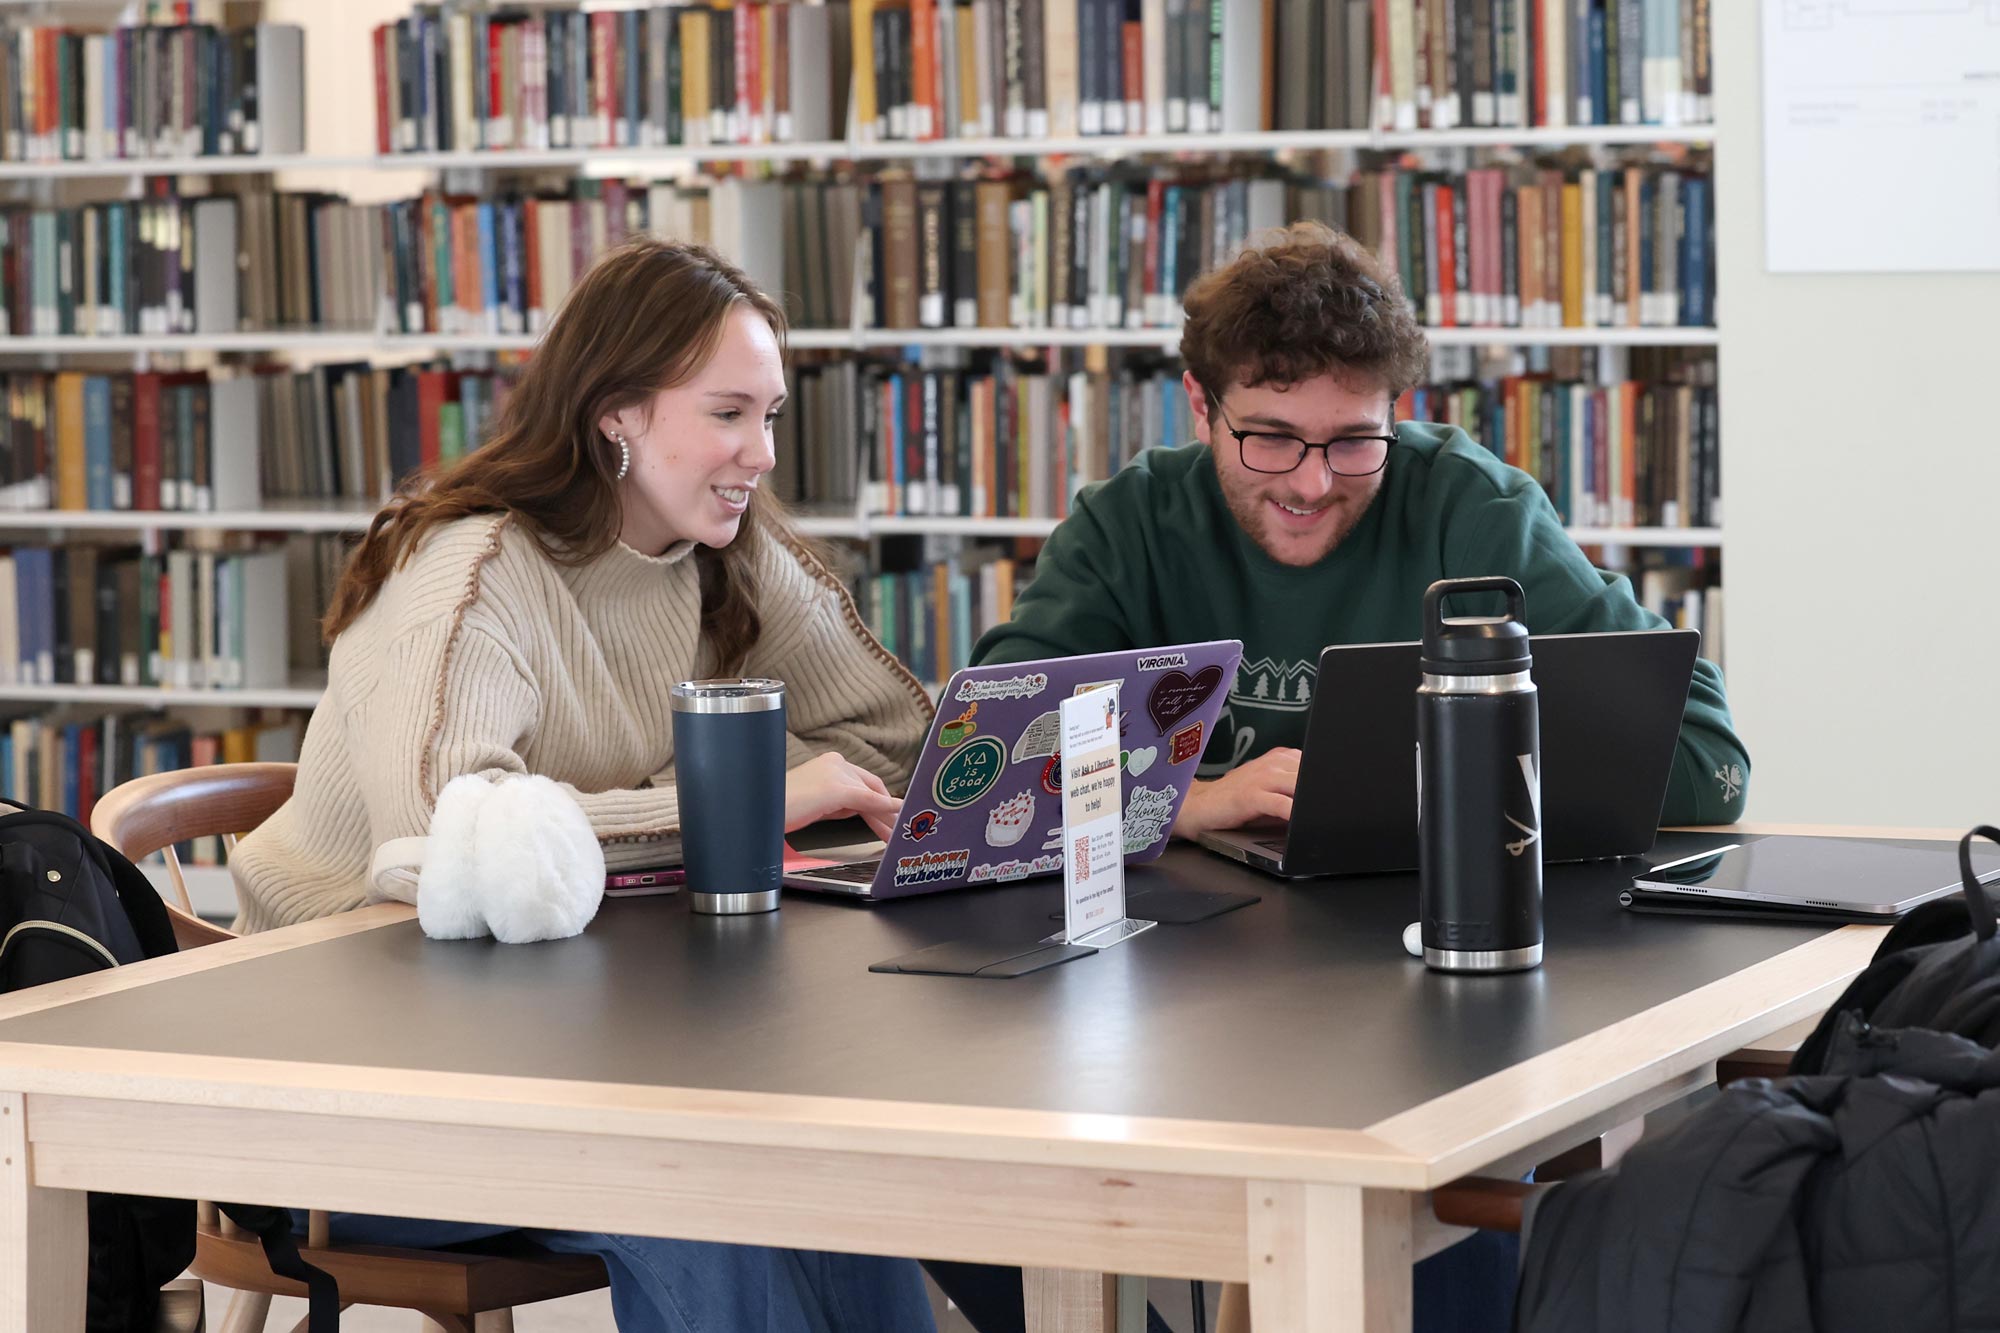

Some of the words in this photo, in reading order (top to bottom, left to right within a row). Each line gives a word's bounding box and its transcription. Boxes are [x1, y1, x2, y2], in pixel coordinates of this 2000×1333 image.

[1139, 656, 1184, 669] VIRGINIA
[1161, 704, 1182, 715] well
[965, 767, 978, 777] is
[1070, 767, 1081, 780] Visit
[1081, 764, 1090, 776] Ask
[1094, 757, 1114, 771] Librarian
[945, 773, 986, 793] good.
[1070, 786, 1079, 798] web
[1102, 776, 1115, 788] happy
[1156, 786, 1177, 801] are
[1127, 803, 1170, 826] doing
[900, 850, 968, 867] wahoowa
[971, 861, 1029, 879] Northern
[1031, 855, 1061, 871] Neck
[896, 866, 964, 885] wahoowa
